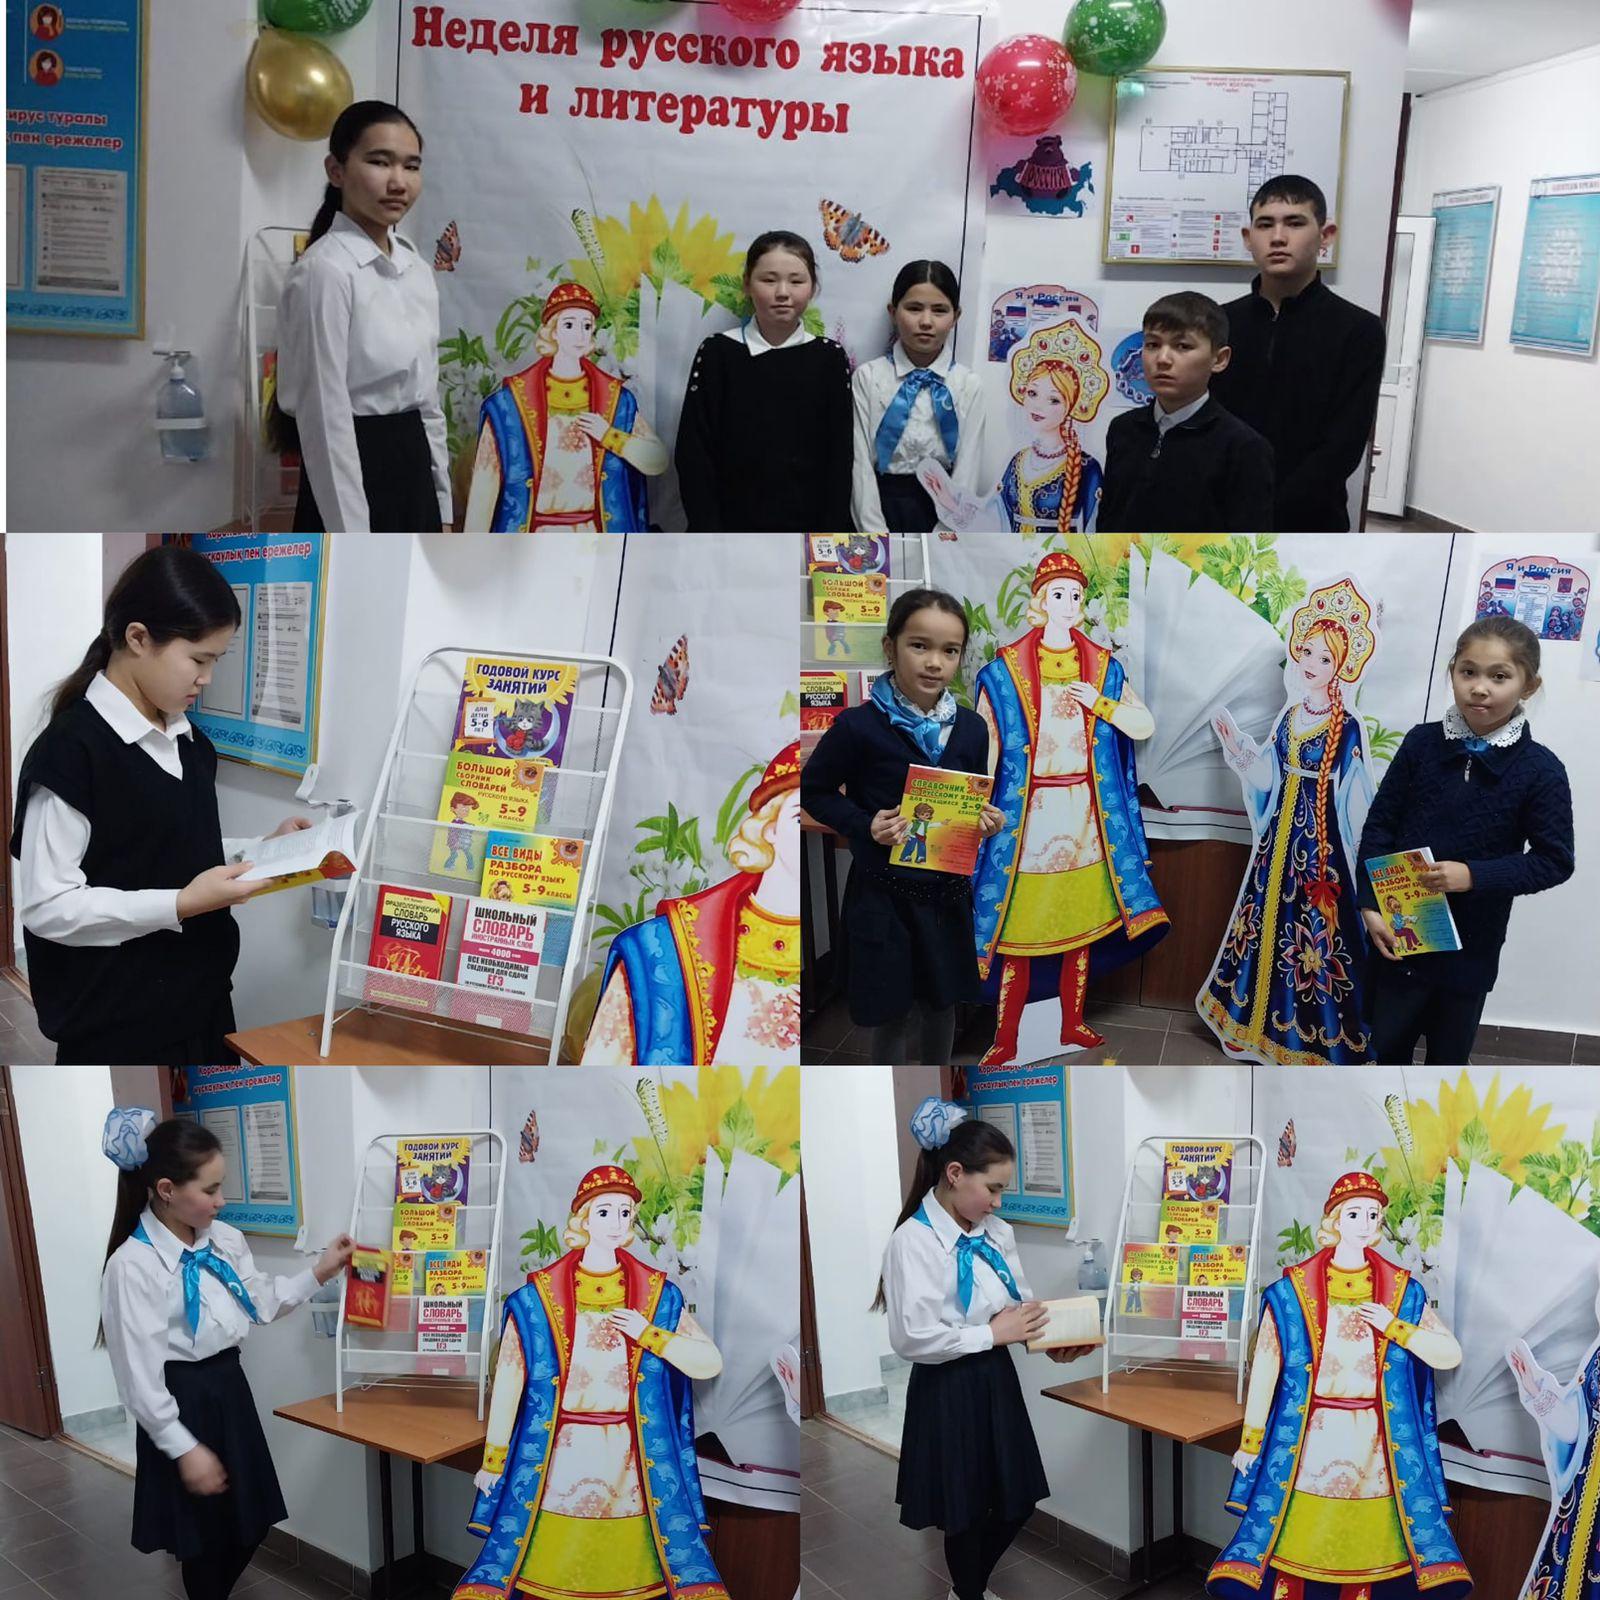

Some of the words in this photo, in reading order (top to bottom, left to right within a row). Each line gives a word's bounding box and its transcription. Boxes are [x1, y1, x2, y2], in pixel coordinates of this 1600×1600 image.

[412, 6, 579, 56] Неделя
[600, 27, 800, 70] русского
[821, 41, 965, 79] языка
[519, 83, 550, 114] и
[569, 86, 850, 140] литературы
[48, 112, 107, 125] туралы
[13, 133, 40, 143] пен
[45, 135, 123, 151] ережелер
[245, 548, 260, 560] пен
[262, 541, 312, 560] ережелер
[1506, 563, 1514, 571] Я
[1528, 564, 1572, 575] Россия
[822, 579, 864, 587] БОЛЬШОЙ
[476, 664, 530, 679] ГОДОВОЙ
[532, 670, 561, 681] КУРС
[486, 679, 547, 694] ЗАНЯТИЙ
[456, 761, 511, 777] БОЛЬШОЙ
[456, 771, 491, 782] СБОРНИК
[460, 779, 507, 793] СЛОВАРЕЙ
[911, 779, 965, 793] СПРАВОЧНИК
[478, 791, 508, 800] РУССКОГО
[922, 789, 958, 800] РУССКОМУ
[491, 845, 509, 858] ВСЕ
[512, 847, 543, 862] ВИДЫ
[490, 860, 542, 873] РАЗБОРА
[501, 871, 539, 881] РУССКОМУ
[541, 875, 565, 884] ЯЗЫКУ
[1375, 876, 1411, 888] РАЗБОРА
[522, 884, 546, 894] 5-9
[546, 890, 572, 899] КЛАССЫ
[393, 908, 428, 921] СЛОВАРЬ
[475, 906, 538, 926] ШКОЛЬНЫЙ
[391, 918, 429, 933] РУССКОГО
[473, 918, 534, 941] СЛОВАРЬ
[395, 928, 421, 940] ЯЗЫКА
[480, 957, 529, 973] НЕОБХОДИМЫЕ
[487, 974, 504, 986] ЕГЭ
[508, 971, 528, 980] СДАЧИ
[404, 1142, 439, 1151] ГОДОВОЙ
[441, 1142, 459, 1150] КУРС
[1172, 1145, 1205, 1153] ГОДОВОЙ
[413, 1151, 452, 1161] ЗАНЯТИЙ
[1179, 1154, 1216, 1163] ЗАНЯТИЙ
[1187, 1298, 1223, 1307] СЛОВАРЬ
[423, 1309, 462, 1318] СЛОВАРЬ
